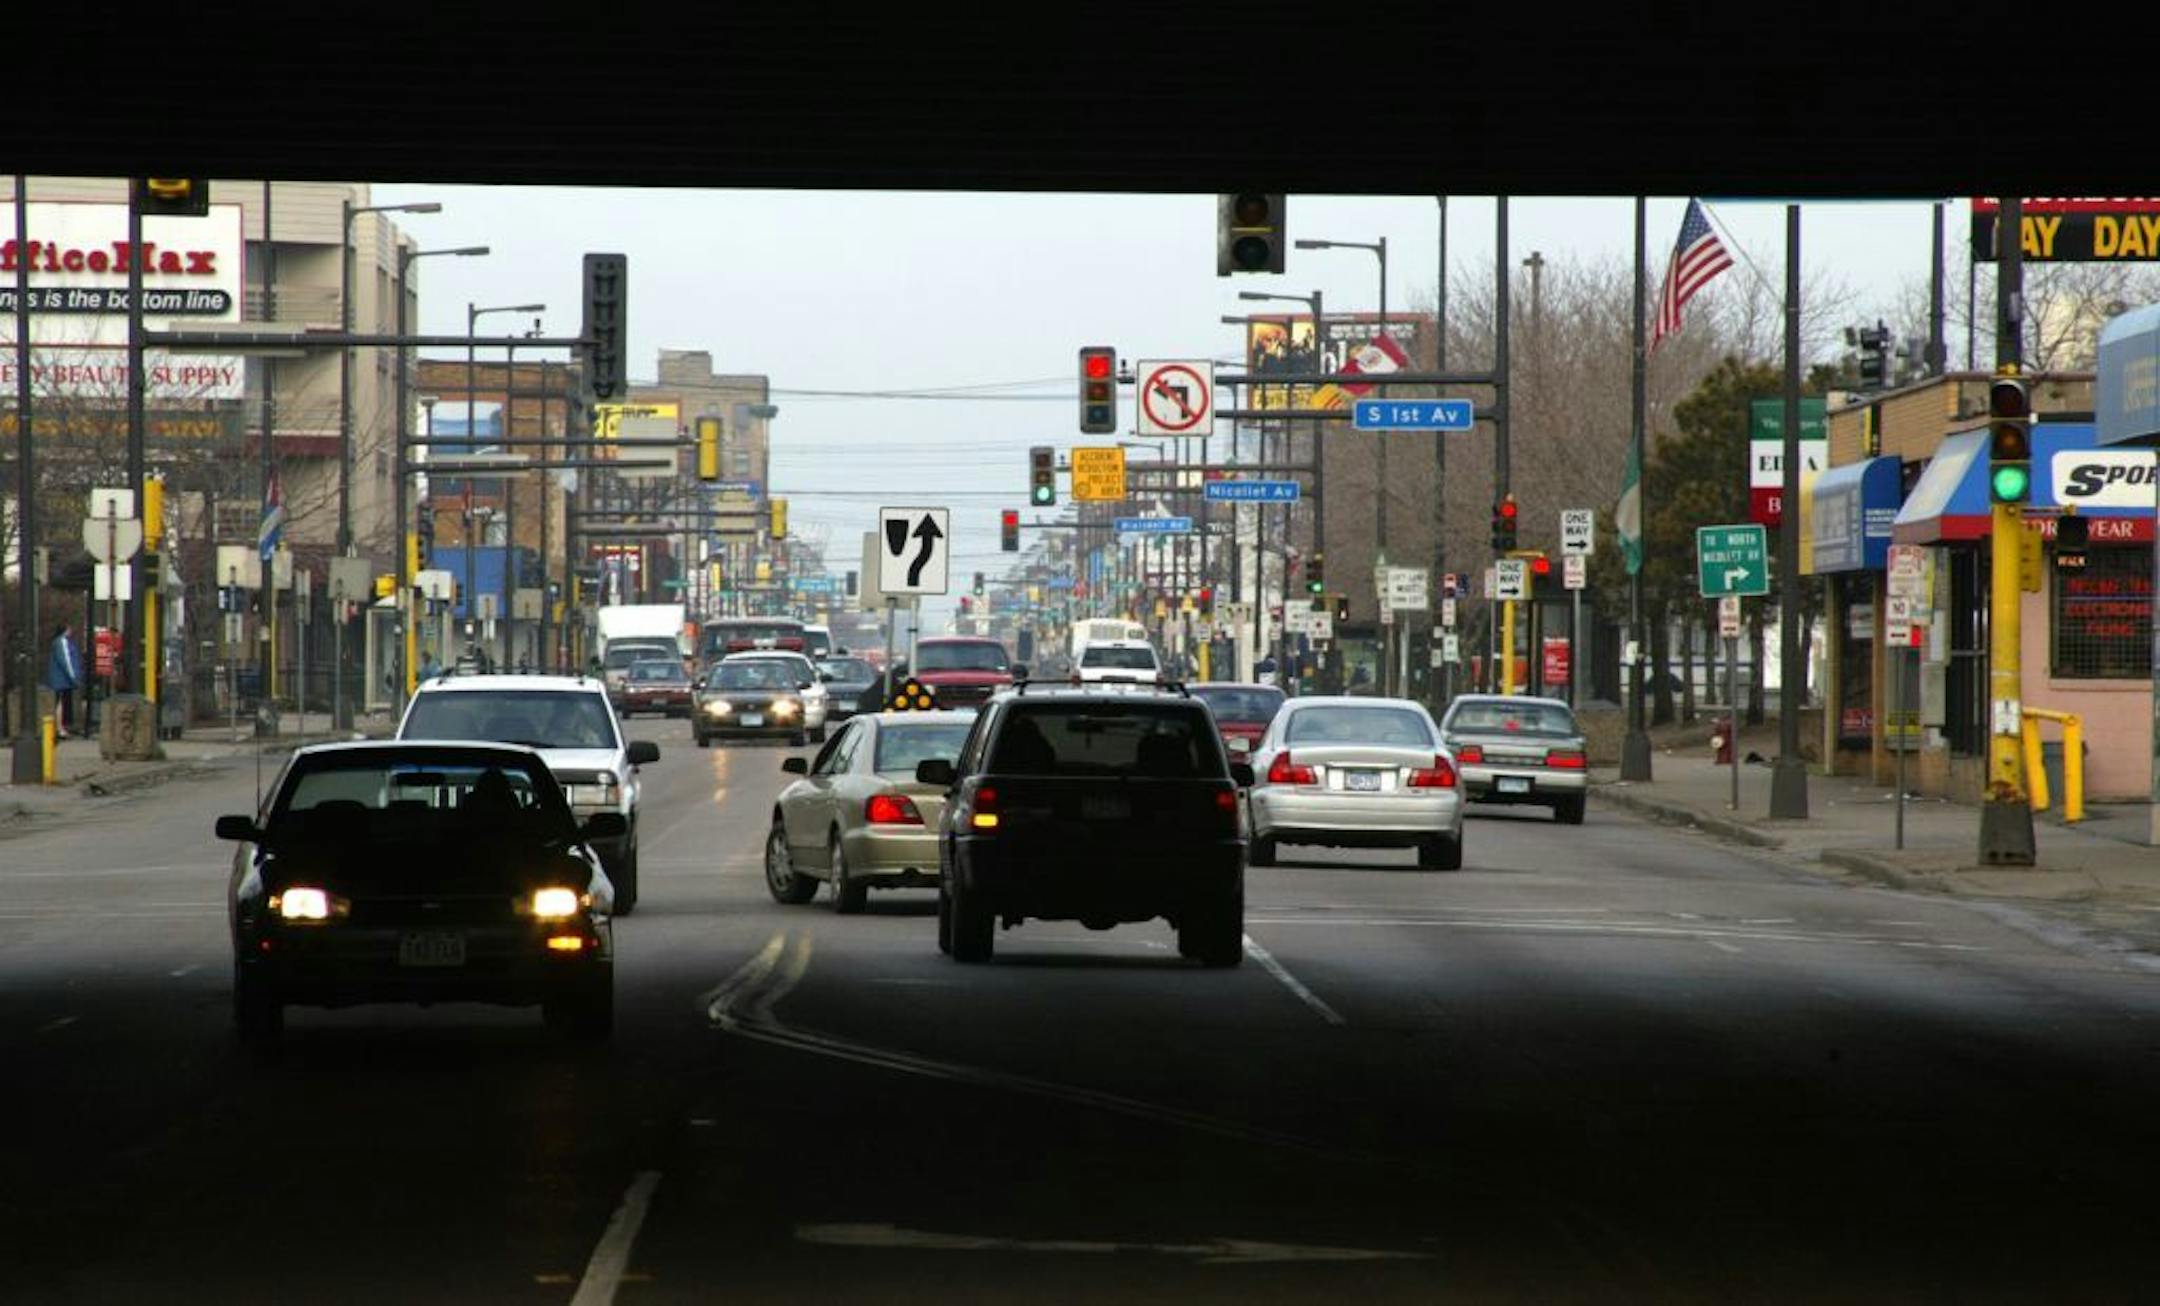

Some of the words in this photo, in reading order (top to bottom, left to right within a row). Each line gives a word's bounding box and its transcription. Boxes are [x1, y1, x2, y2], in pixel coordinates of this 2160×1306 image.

[2020, 216, 2062, 257] AY
[2094, 216, 2160, 257] DAY
[44, 290, 64, 307] is
[68, 290, 101, 308] the
[107, 290, 181, 309] botom
[185, 291, 224, 308] line
[0, 364, 46, 384] EY
[53, 364, 131, 386] BEAUT
[153, 367, 235, 386] SUPPLY
[1368, 406, 1381, 422] S
[1392, 407, 1419, 423] 1st
[1432, 407, 1458, 423] Av
[1209, 485, 1267, 498] Nicollet
[1273, 486, 1293, 498] Av
[1565, 512, 1589, 524] ONE
[1565, 525, 1589, 536] WAY
[1727, 532, 1757, 546] NORTH
[1500, 562, 1521, 572] ONE
[1500, 574, 1521, 583] WAY
